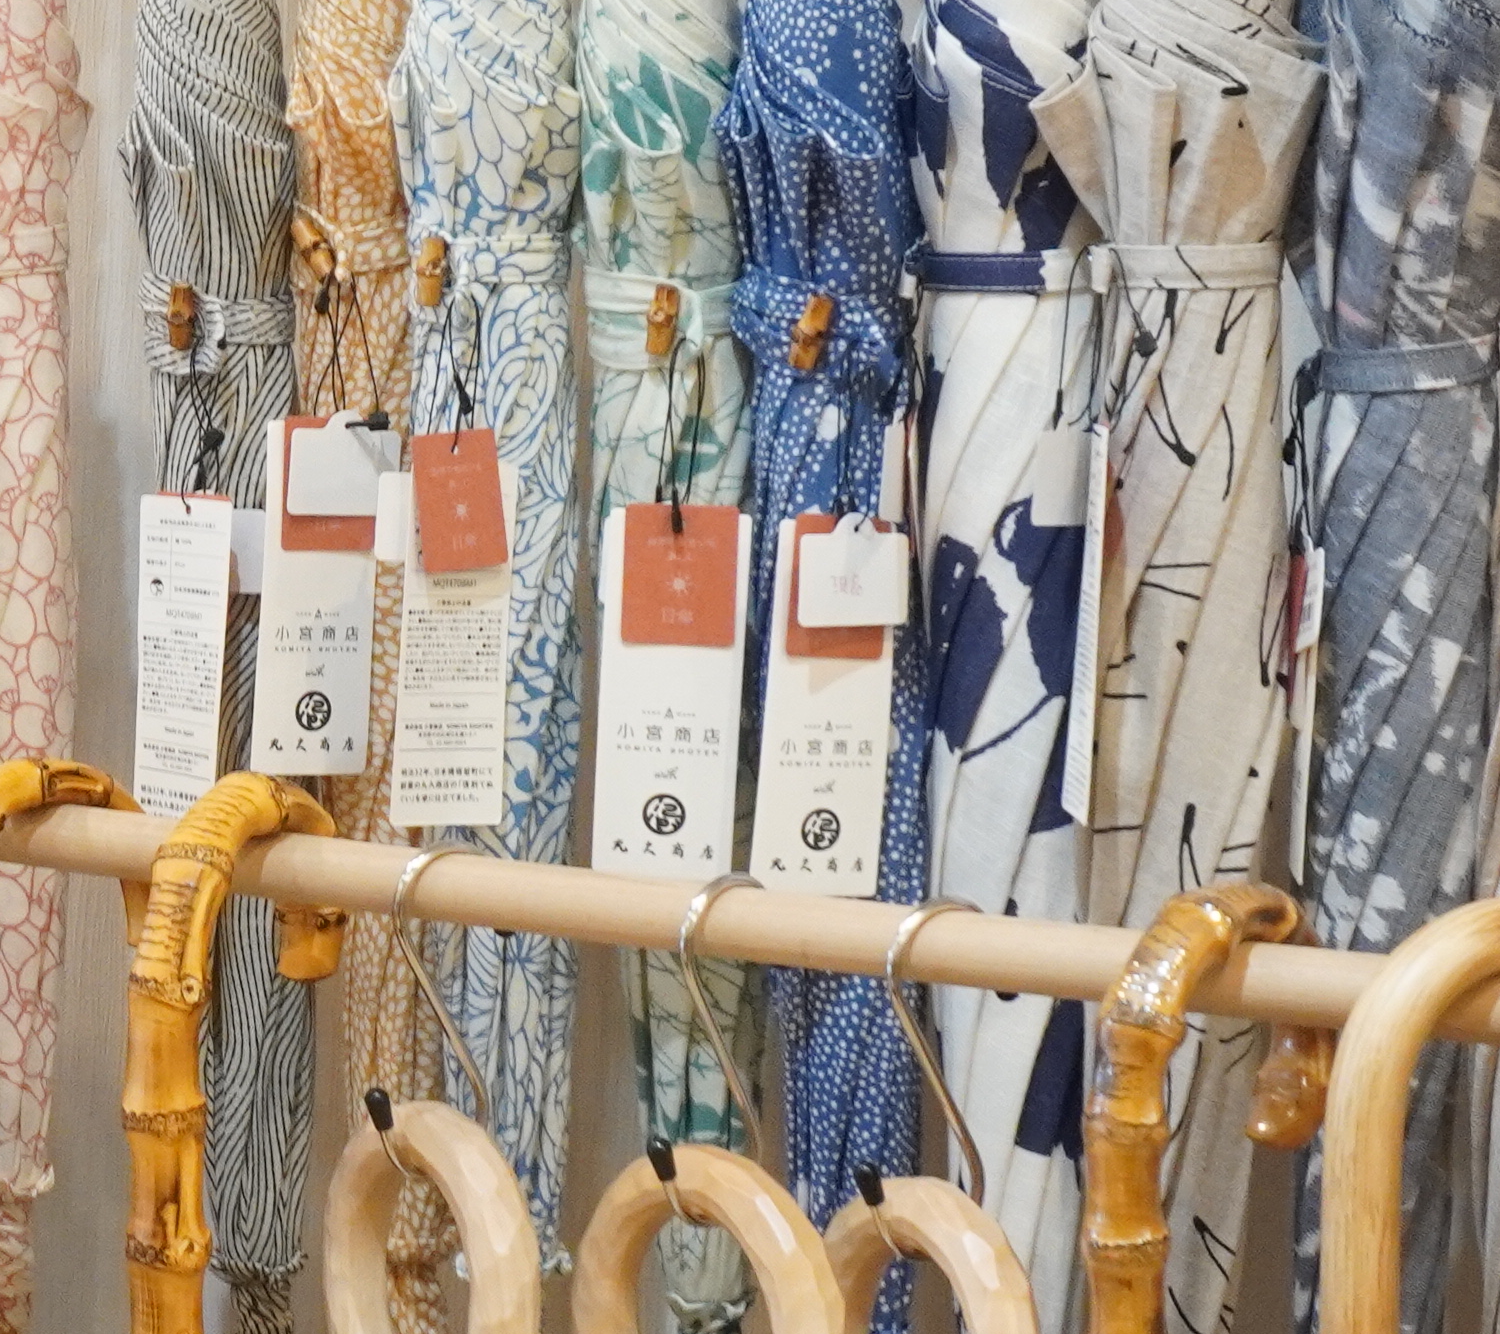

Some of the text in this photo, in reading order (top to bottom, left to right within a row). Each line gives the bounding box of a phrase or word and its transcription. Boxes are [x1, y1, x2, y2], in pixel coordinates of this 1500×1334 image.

[274, 625, 360, 643] 小宮商店
[617, 724, 721, 745] 小宮商店
[616, 744, 719, 757] KOMIYA SHOTEN
[780, 737, 874, 757] 小宮商店
